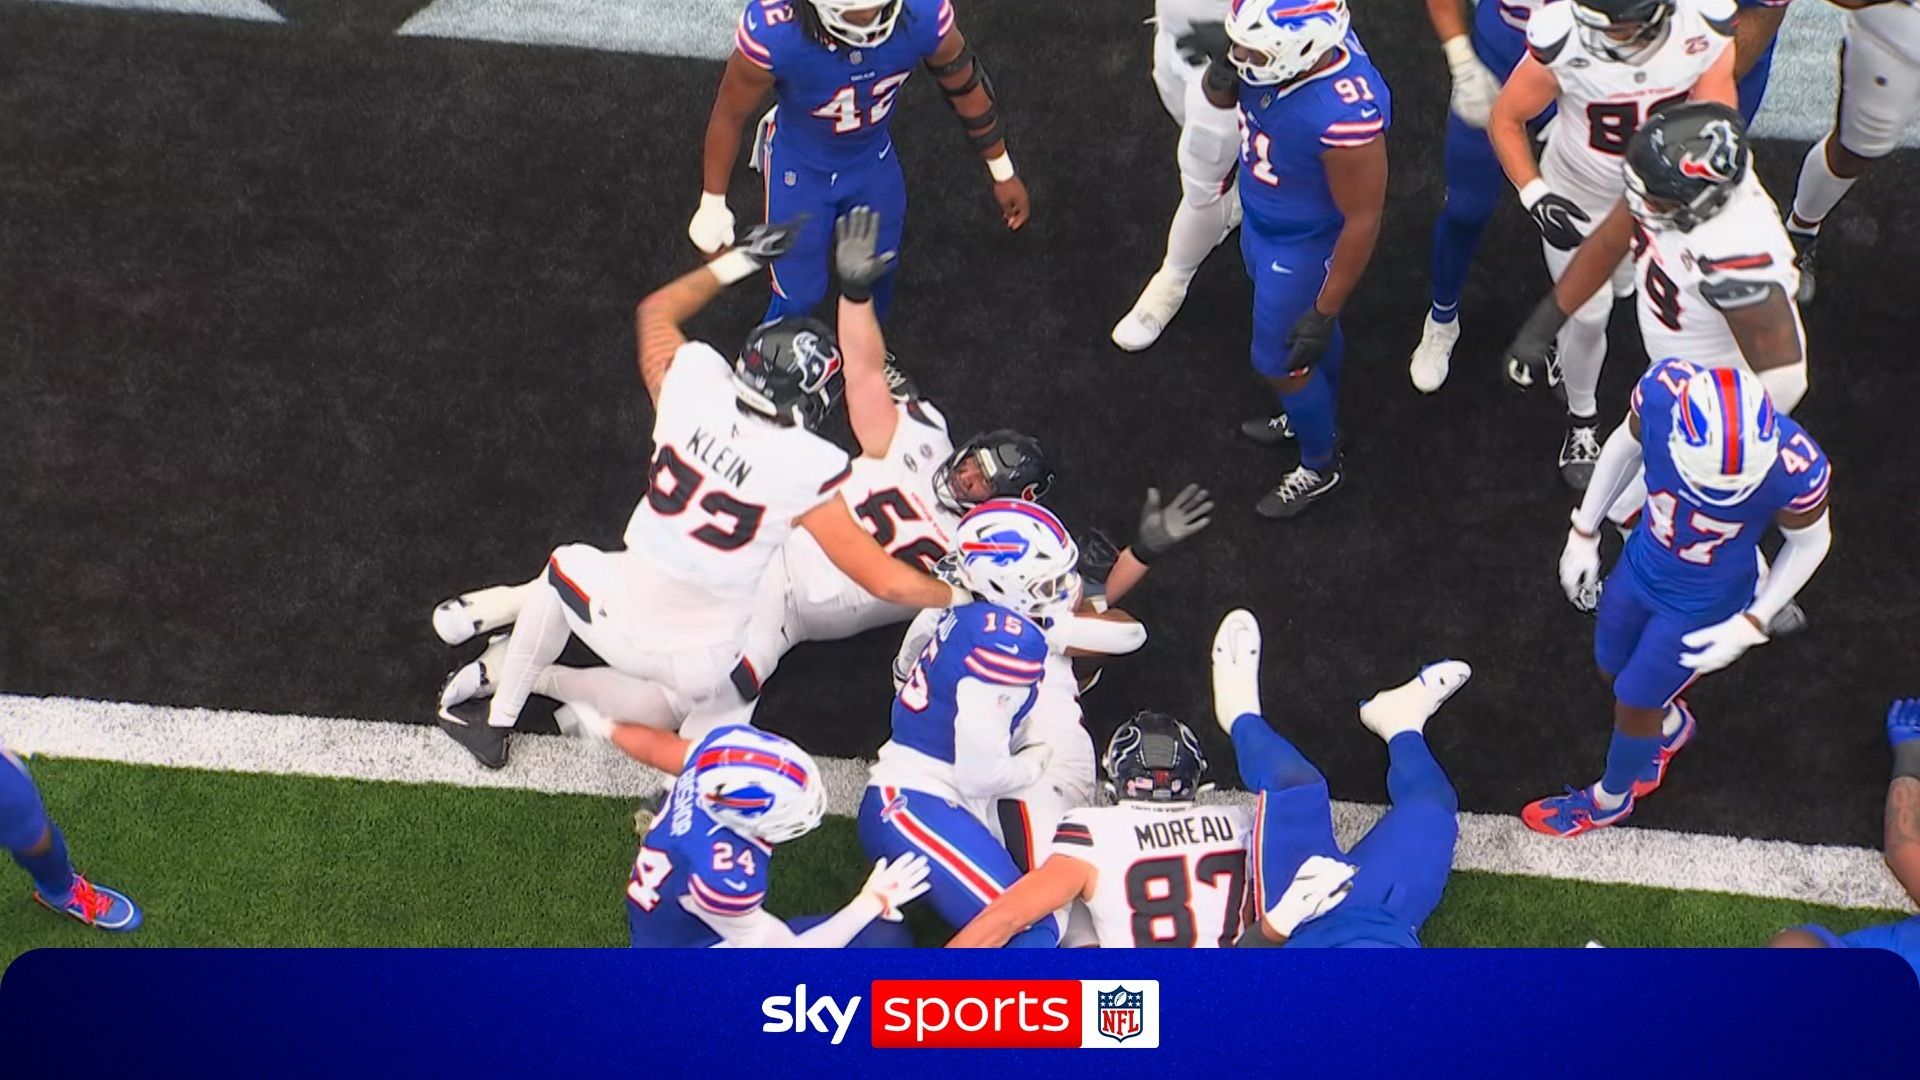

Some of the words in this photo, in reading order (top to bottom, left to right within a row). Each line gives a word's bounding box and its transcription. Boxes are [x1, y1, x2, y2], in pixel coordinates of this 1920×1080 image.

[810, 69, 912, 135] 42
[1332, 74, 1375, 105] 91
[686, 426, 753, 488] KLEIN
[1780, 433, 1819, 475] 47
[1647, 489, 1744, 566] 47
[983, 612, 1022, 636] 15
[1134, 816, 1234, 851] MOREAU
[712, 841, 756, 876] 24
[1124, 849, 1248, 947] 87
